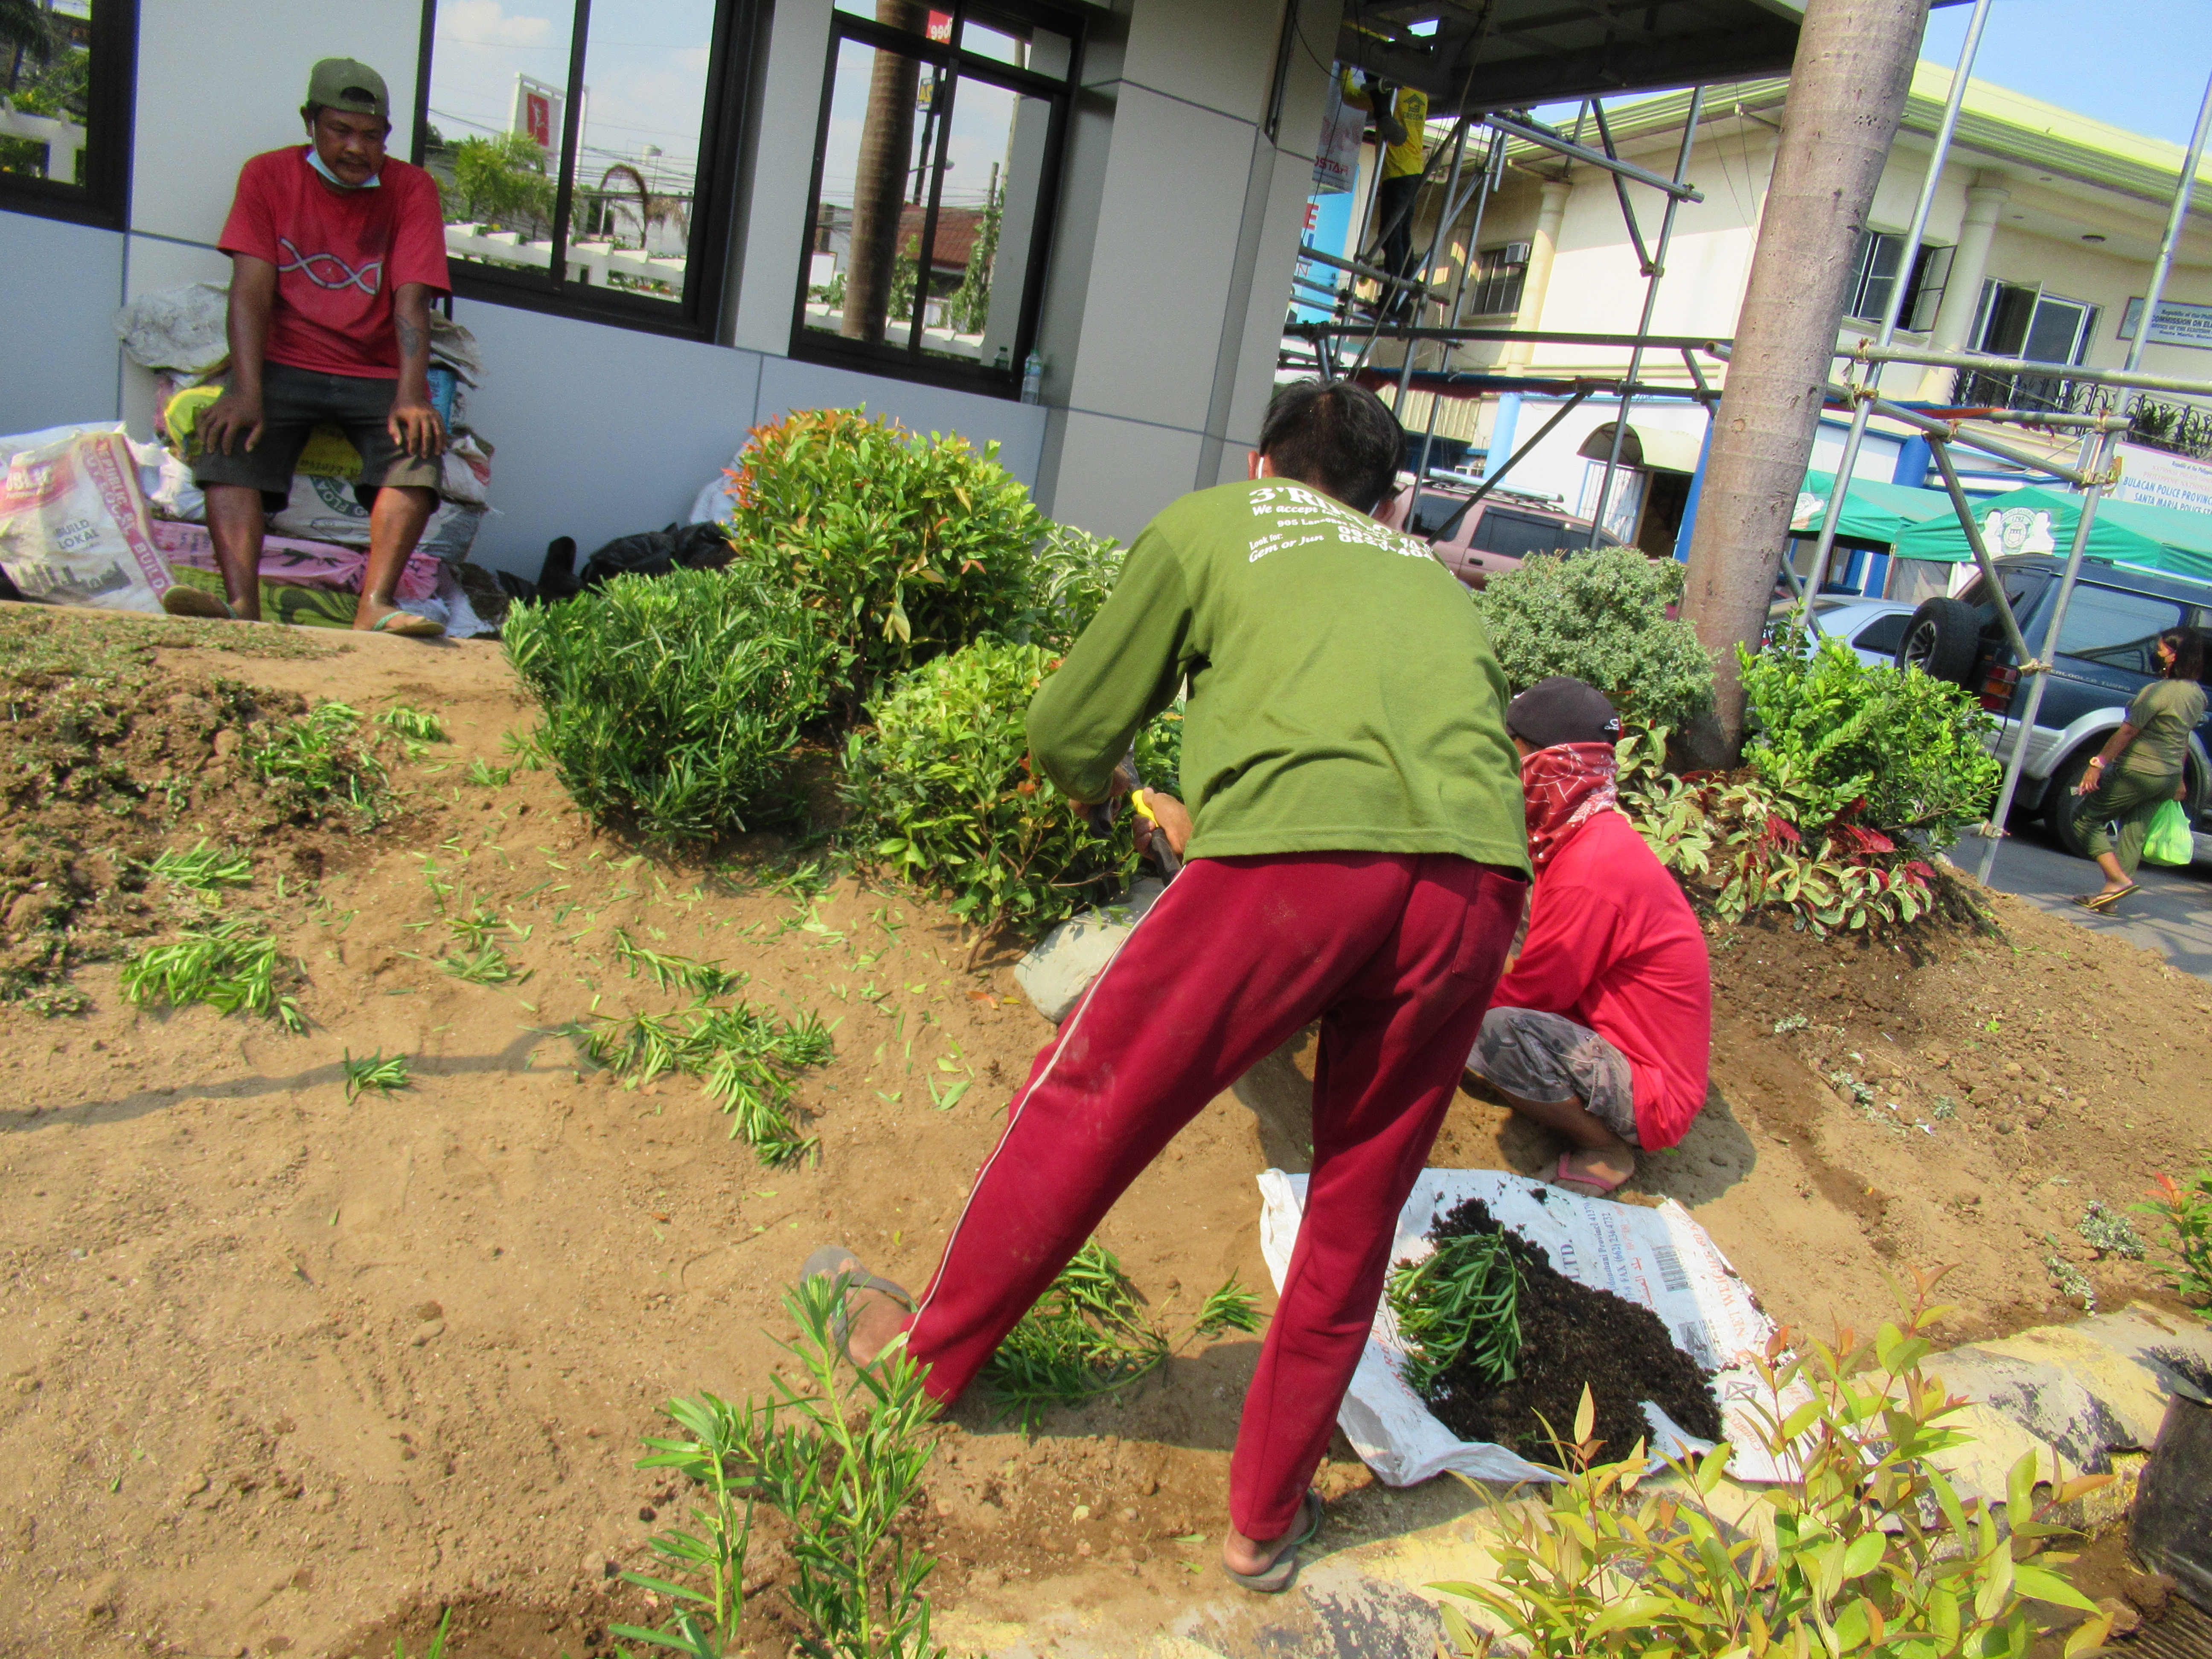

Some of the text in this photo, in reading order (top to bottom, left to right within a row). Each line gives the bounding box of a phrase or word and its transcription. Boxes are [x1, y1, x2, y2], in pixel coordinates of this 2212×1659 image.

[2152, 315, 2192, 326] COMMISSION
[2123, 476, 2155, 492] BULACAN
[2156, 485, 2181, 498] POLICE
[2143, 472, 2178, 484] PHILIPPINE
[1252, 504, 1273, 516] We
[1276, 505, 1318, 515] accept
[2133, 492, 2155, 505] SANTA
[2156, 498, 2178, 511] MARIA
[55, 518, 90, 538] BUILD
[1277, 519, 1298, 527] 905
[58, 529, 100, 550] LOKAL
[1249, 533, 1284, 551] Look for:
[1249, 535, 1325, 563] Gem or Jun
[133, 541, 167, 589] BUILD
[1602, 1211, 1616, 1230] 4732
[1608, 1229, 1620, 1243] 236
[1560, 1238, 1581, 1281] LTD.
[1611, 1244, 1624, 1263] (662)
[1618, 1265, 1630, 1283] FAX
[1728, 1313, 1746, 1338] NET
